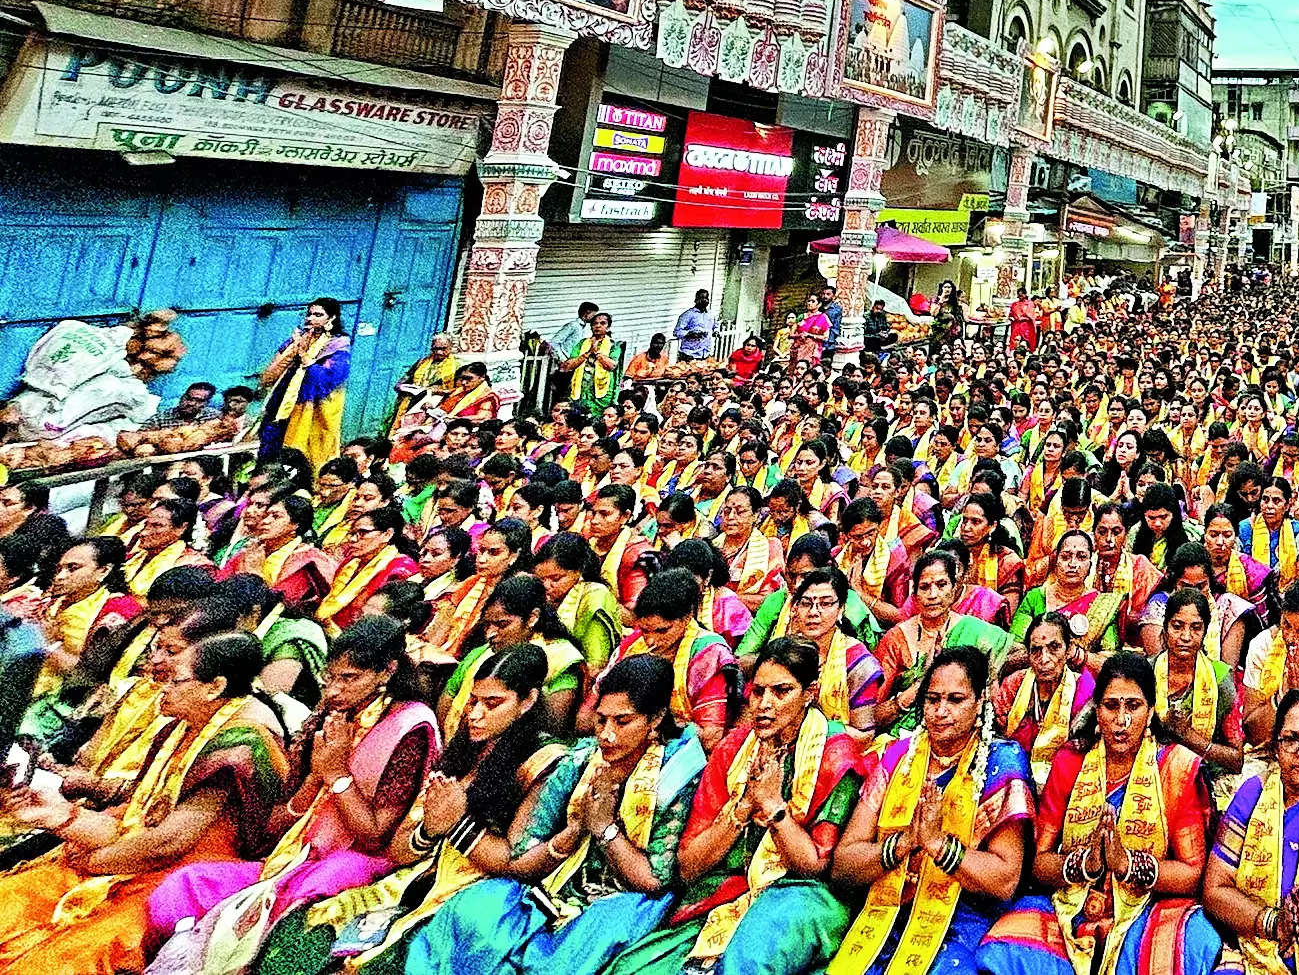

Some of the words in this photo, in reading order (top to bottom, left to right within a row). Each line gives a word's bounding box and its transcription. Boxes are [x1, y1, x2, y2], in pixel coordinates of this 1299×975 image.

[279, 92, 413, 123] GLASSWARE
[413, 110, 475, 130] STORE
[626, 111, 664, 130] TITAN
[111, 128, 186, 151] पूना
[614, 135, 648, 147] SONATA
[600, 204, 649, 216] fastrack
